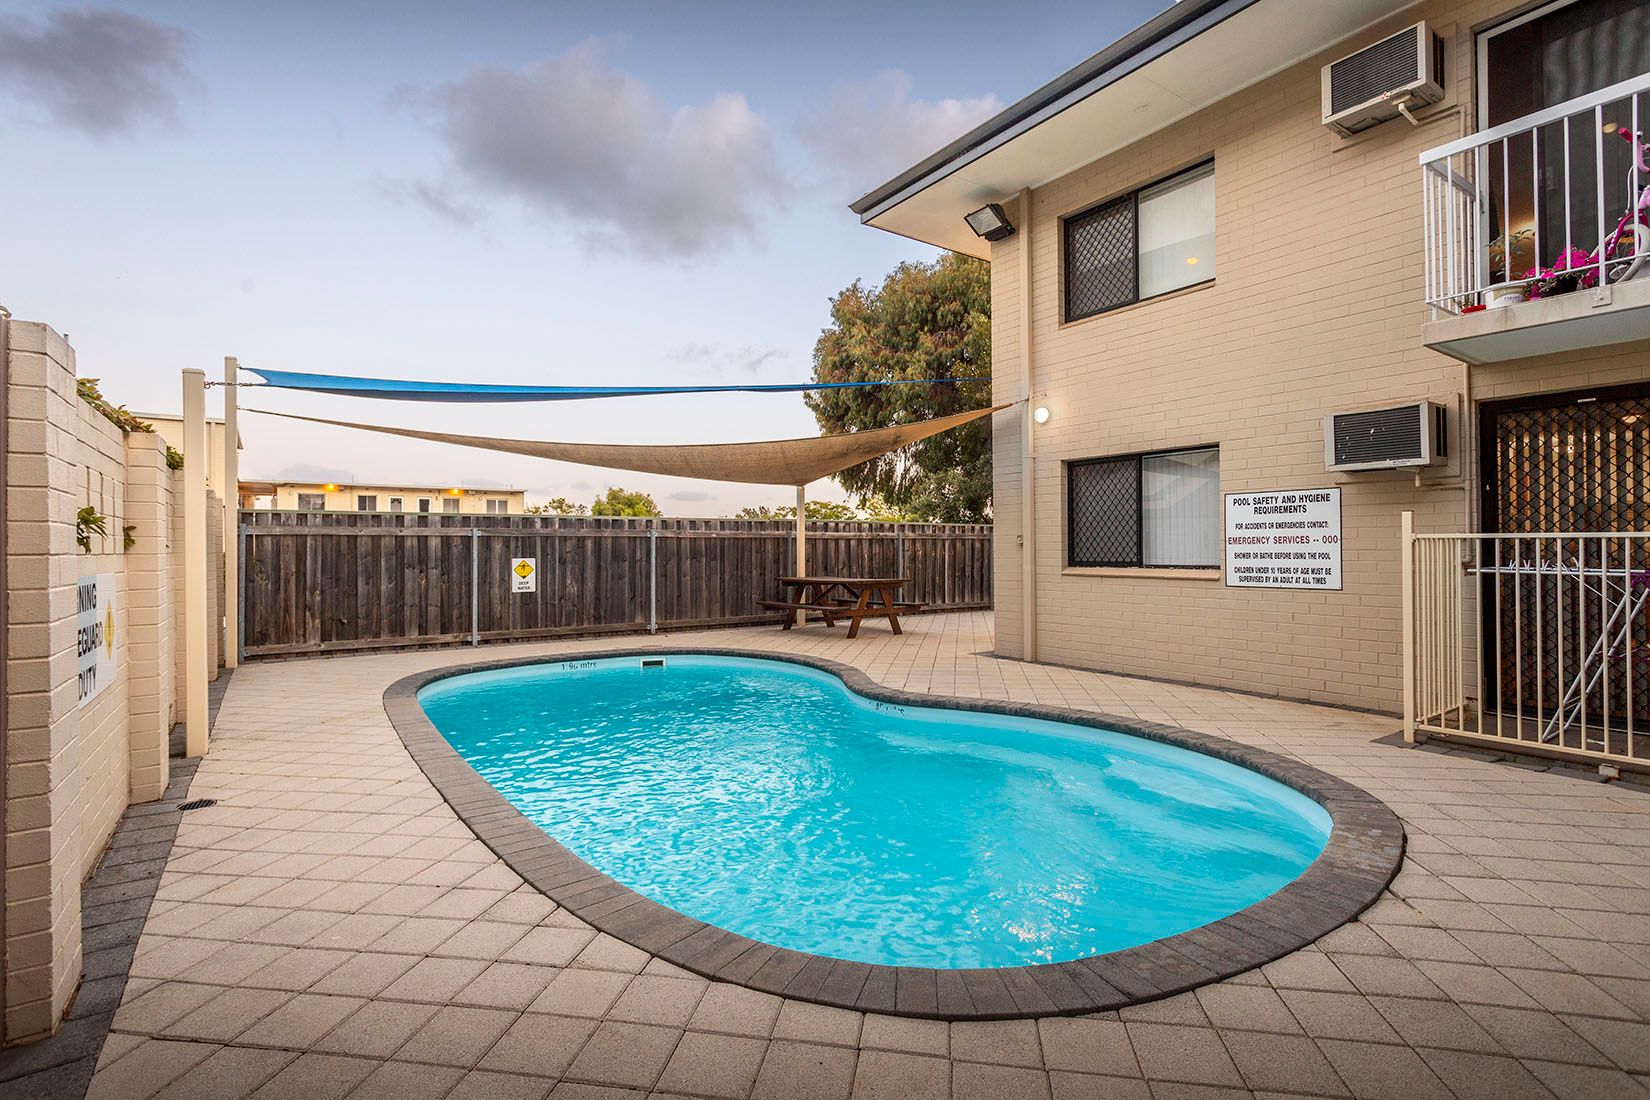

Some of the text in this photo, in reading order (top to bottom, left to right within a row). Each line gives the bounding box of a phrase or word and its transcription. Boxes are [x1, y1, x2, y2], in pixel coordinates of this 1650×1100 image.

[1233, 493, 1330, 506] POOL SAFETY AND HYGIENE
[1254, 504, 1307, 514] REQUIREMENTS
[1244, 522, 1267, 530] ACCIDENTS
[1228, 536, 1270, 544] EMERGENCY
[1273, 536, 1310, 544] SERVICES
[77, 583, 96, 614] NING
[78, 663, 97, 701] DUTY
